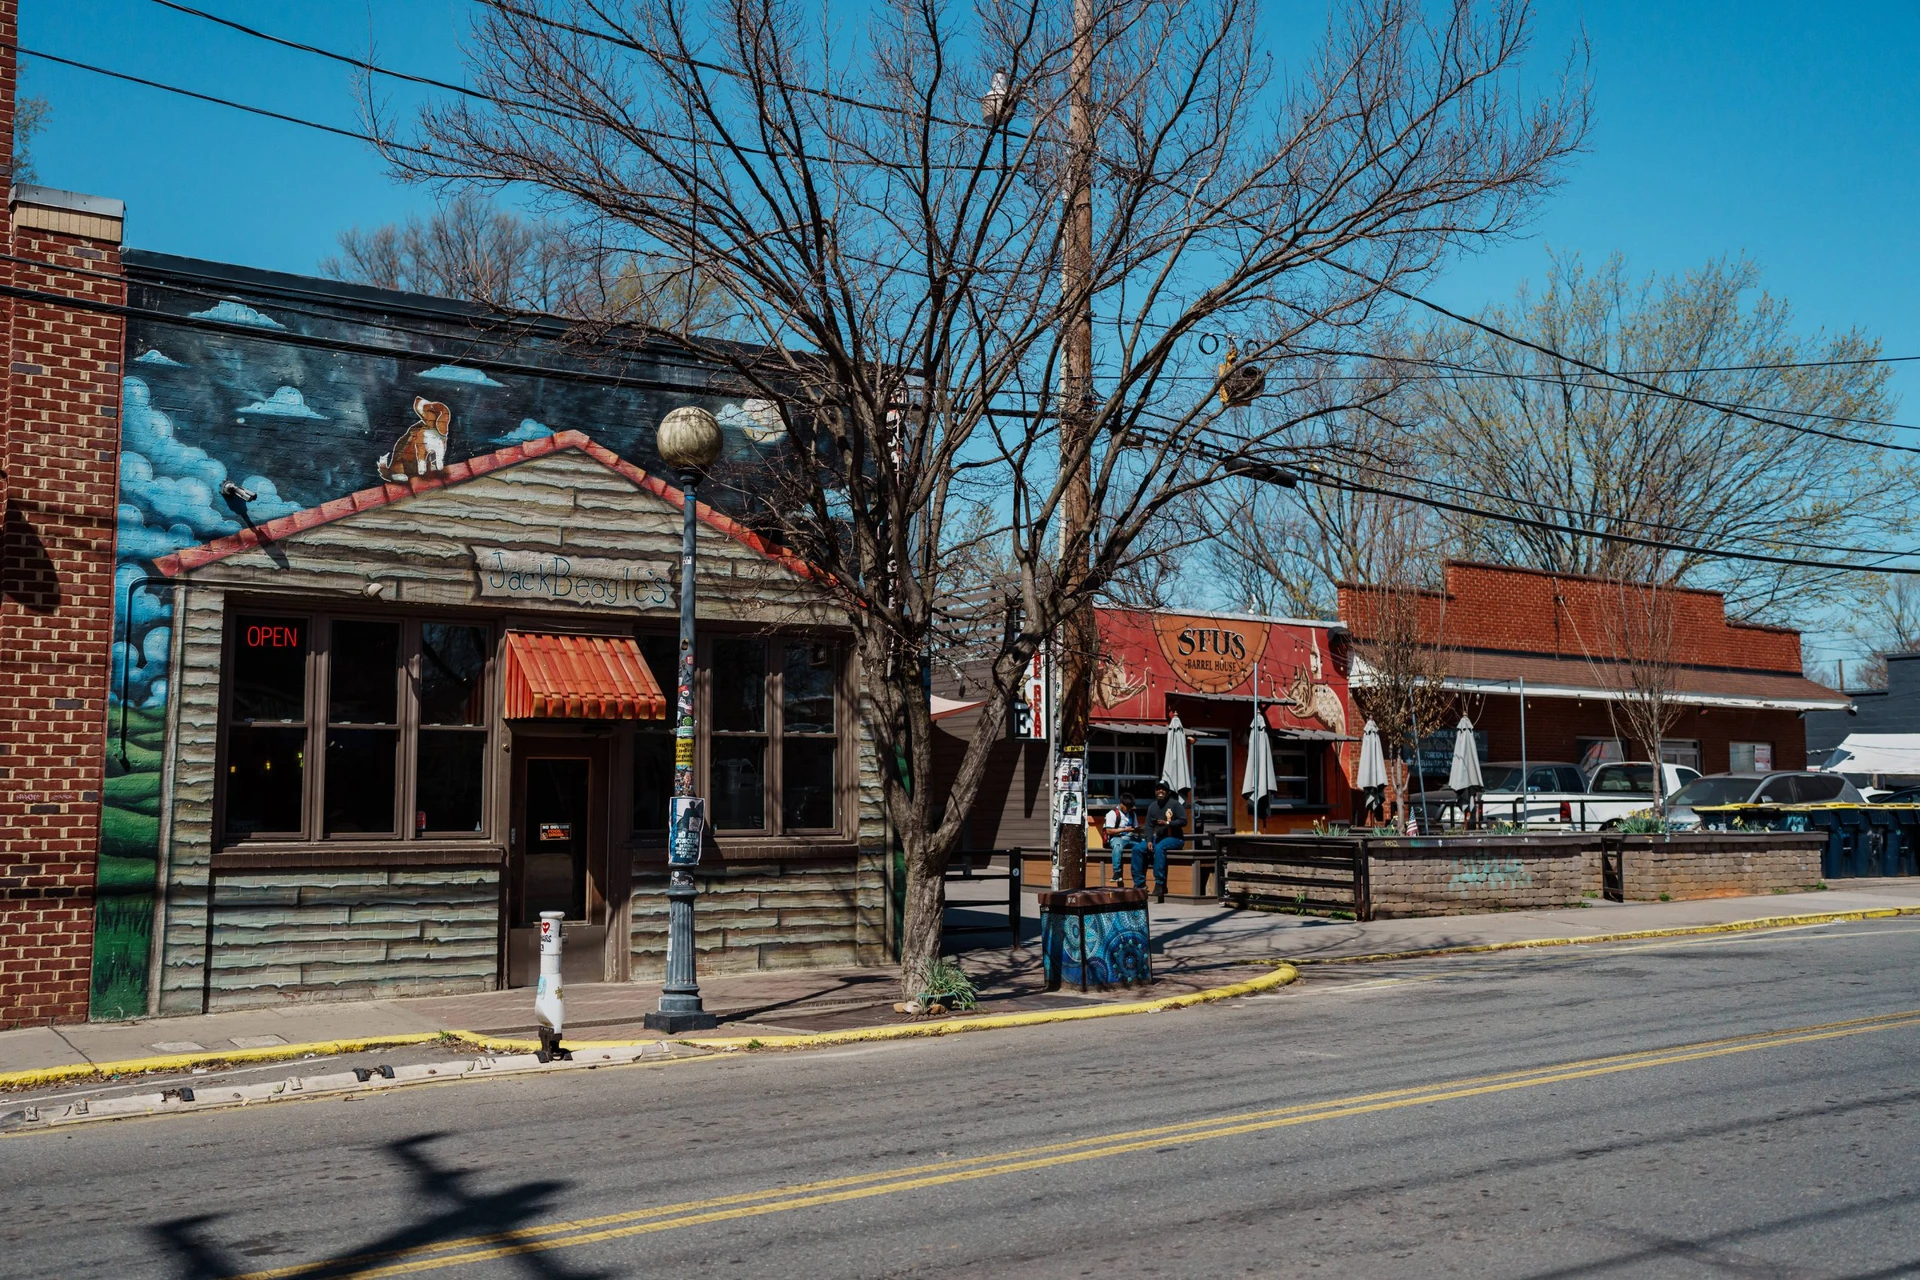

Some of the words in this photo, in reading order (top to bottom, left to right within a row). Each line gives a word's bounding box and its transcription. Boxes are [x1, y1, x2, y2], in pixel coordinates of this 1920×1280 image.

[247, 625, 298, 648] OPEN
[1187, 658, 1213, 671] BARREL
[1214, 659, 1237, 673] HOUSE
